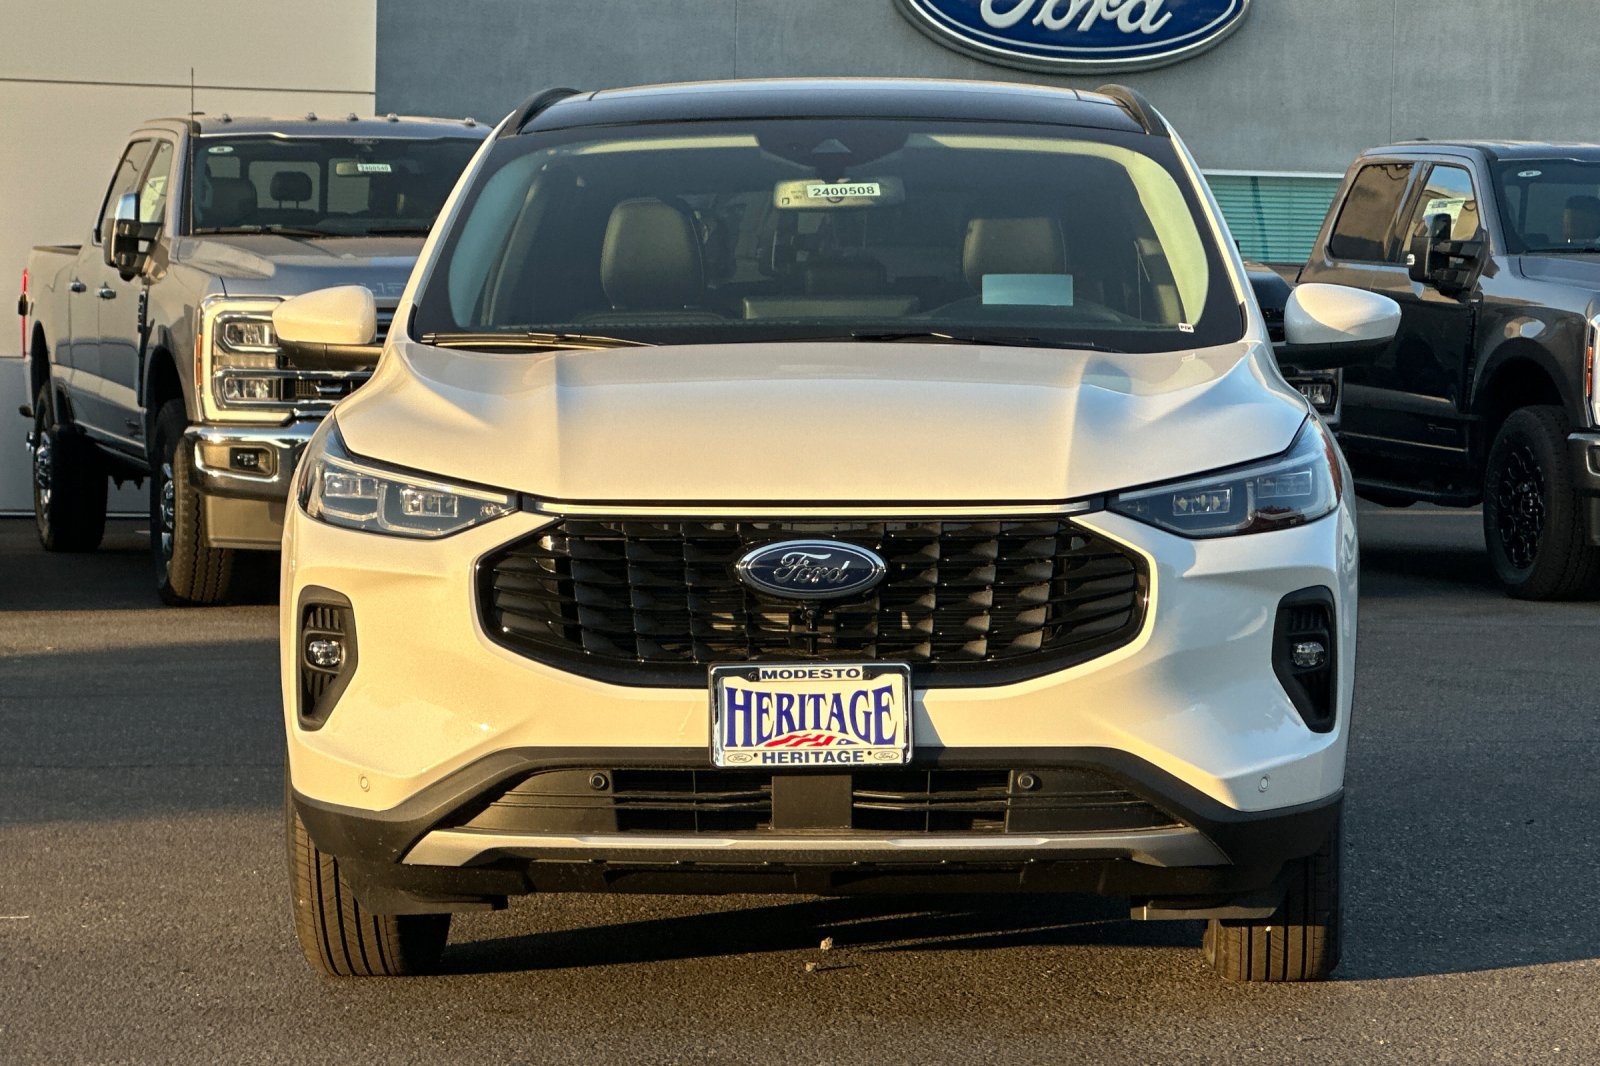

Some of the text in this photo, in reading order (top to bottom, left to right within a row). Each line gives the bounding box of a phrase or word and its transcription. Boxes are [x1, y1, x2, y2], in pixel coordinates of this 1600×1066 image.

[812, 186, 875, 196] 2400508
[774, 552, 850, 583] Ford
[761, 668, 861, 679] MODESTO
[725, 685, 897, 747] HERITAGE
[762, 751, 864, 763] HERITAGE
